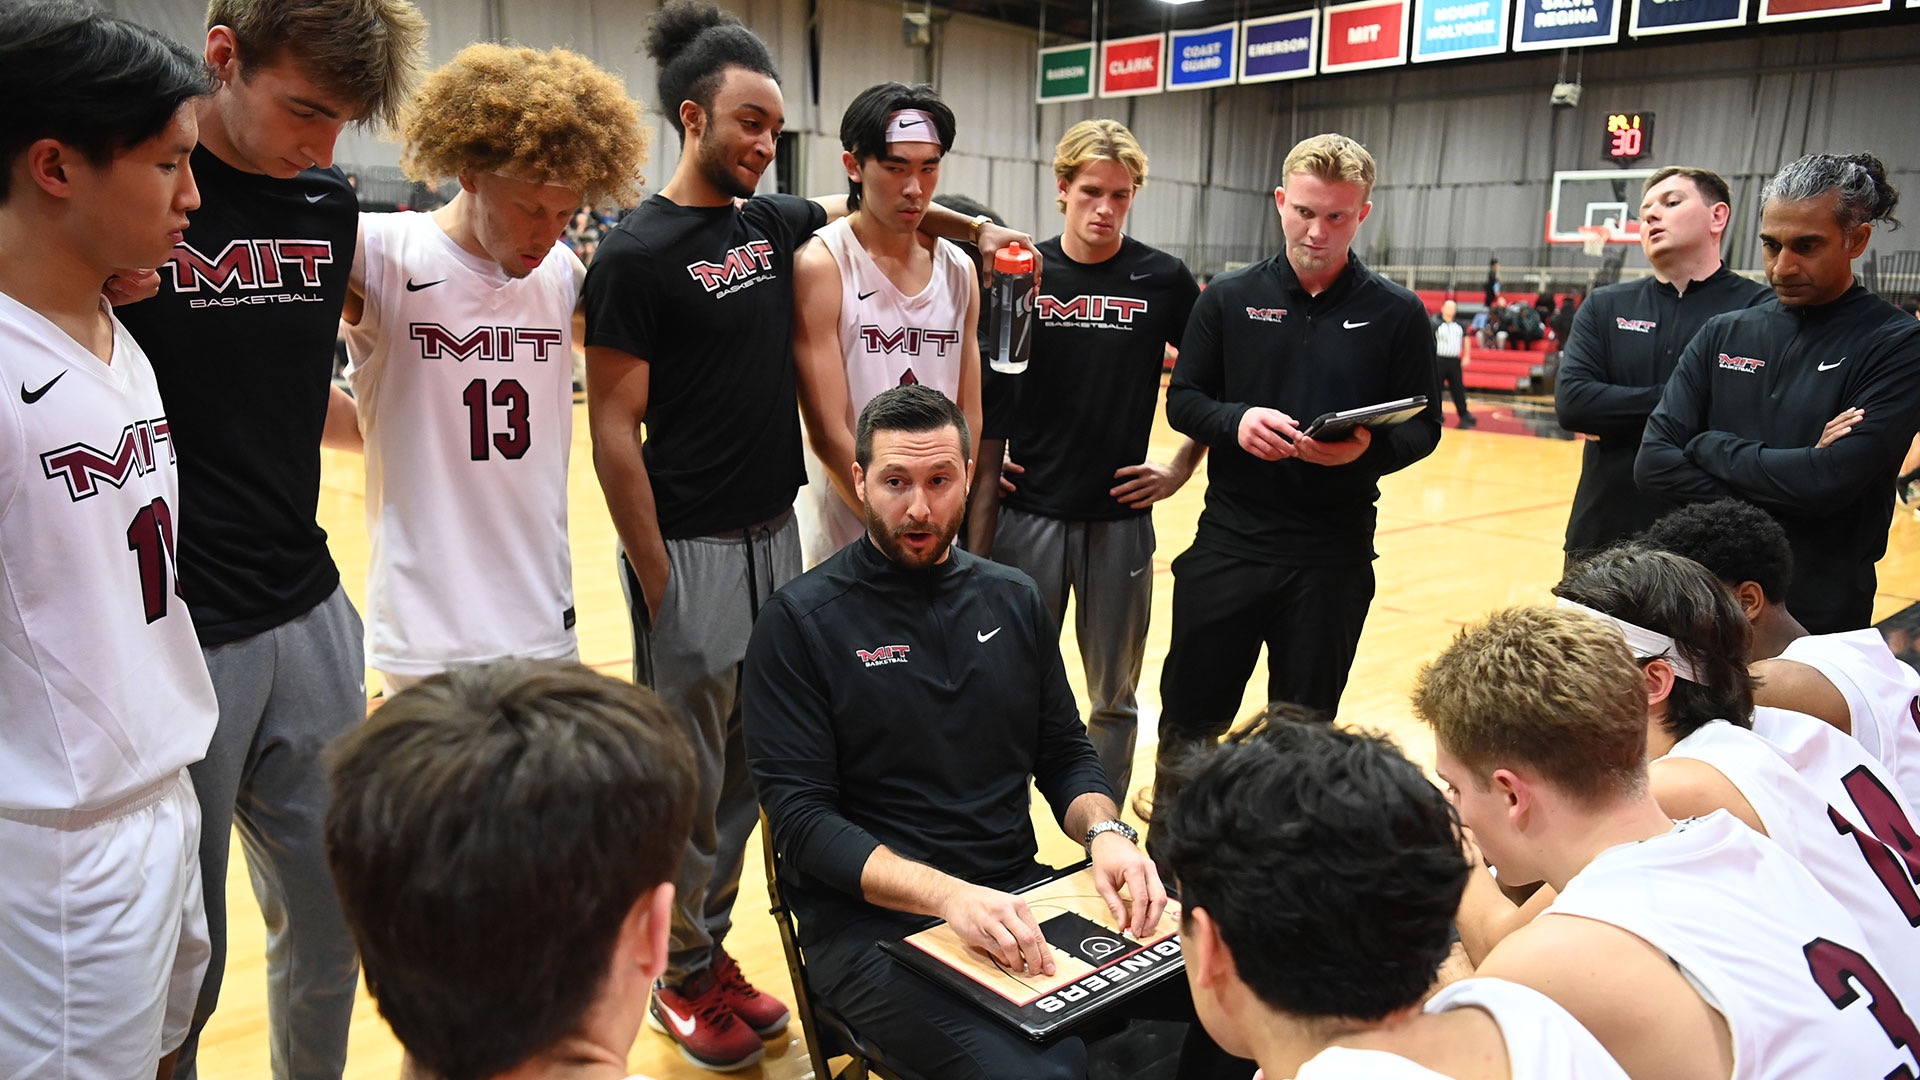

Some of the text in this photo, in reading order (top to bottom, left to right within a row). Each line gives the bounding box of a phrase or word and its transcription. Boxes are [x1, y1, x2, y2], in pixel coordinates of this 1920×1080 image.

[1434, 2, 1490, 22] MOUNT
[1534, 7, 1598, 28] REGINA
[1347, 23, 1382, 45] MIT
[1426, 19, 1496, 41] HOLYOKE
[1182, 42, 1222, 59] COAST
[1248, 37, 1309, 58] EMERSON
[1109, 57, 1154, 76] CLARK
[1181, 56, 1222, 73] GUARD
[1611, 129, 1641, 156] 30
[162, 239, 333, 293] MIT
[687, 240, 774, 292] MIT
[190, 293, 324, 308] BASKETBALL
[1035, 295, 1147, 322] MIT
[1246, 306, 1287, 319] MIT
[1045, 321, 1133, 330] BASKETBALL
[410, 322, 562, 361] MIT
[861, 325, 958, 357] MIT
[1719, 353, 1765, 370] MIT
[463, 379, 531, 461] 13
[856, 645, 910, 662] MIT
[865, 657, 908, 668] BASKETBALL
[1035, 935, 1181, 1013] GINEERS
